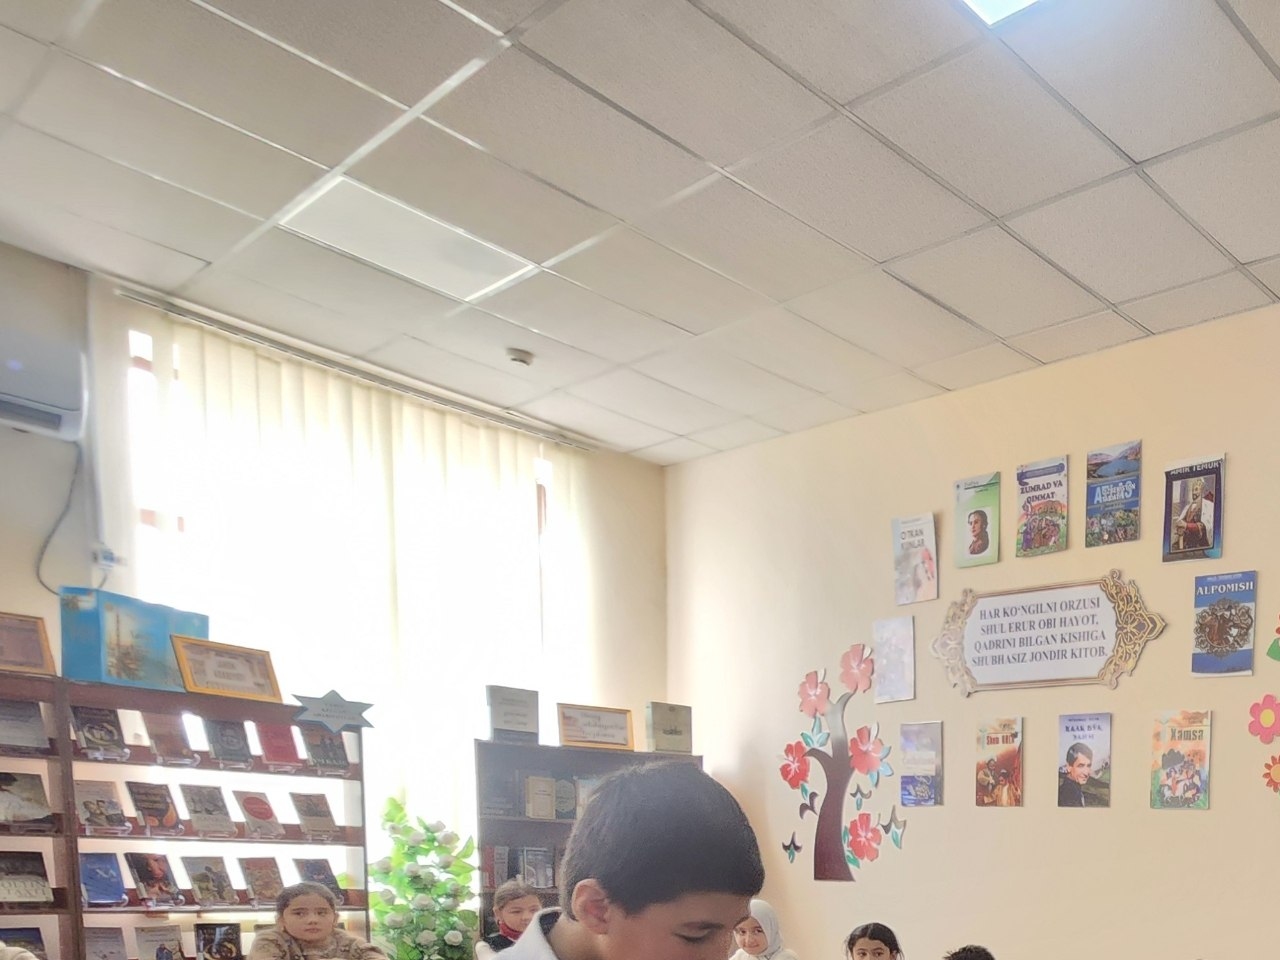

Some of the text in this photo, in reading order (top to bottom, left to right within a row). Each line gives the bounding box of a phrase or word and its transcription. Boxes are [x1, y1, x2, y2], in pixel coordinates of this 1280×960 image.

[1196, 581, 1253, 595] ALPOMISH
[980, 608, 1000, 620] HAR
[1060, 597, 1100, 612] ORZUSI
[981, 624, 1006, 635] SHUL
[1009, 621, 1036, 633] ERUR
[1038, 618, 1056, 630] OBI
[974, 630, 1106, 653] QADRINI BILGAN KISHIGA
[972, 652, 1027, 667] SHUBHASIZ
[1029, 649, 1068, 663] JONDIR
[1170, 728, 1204, 741] Xamsa
